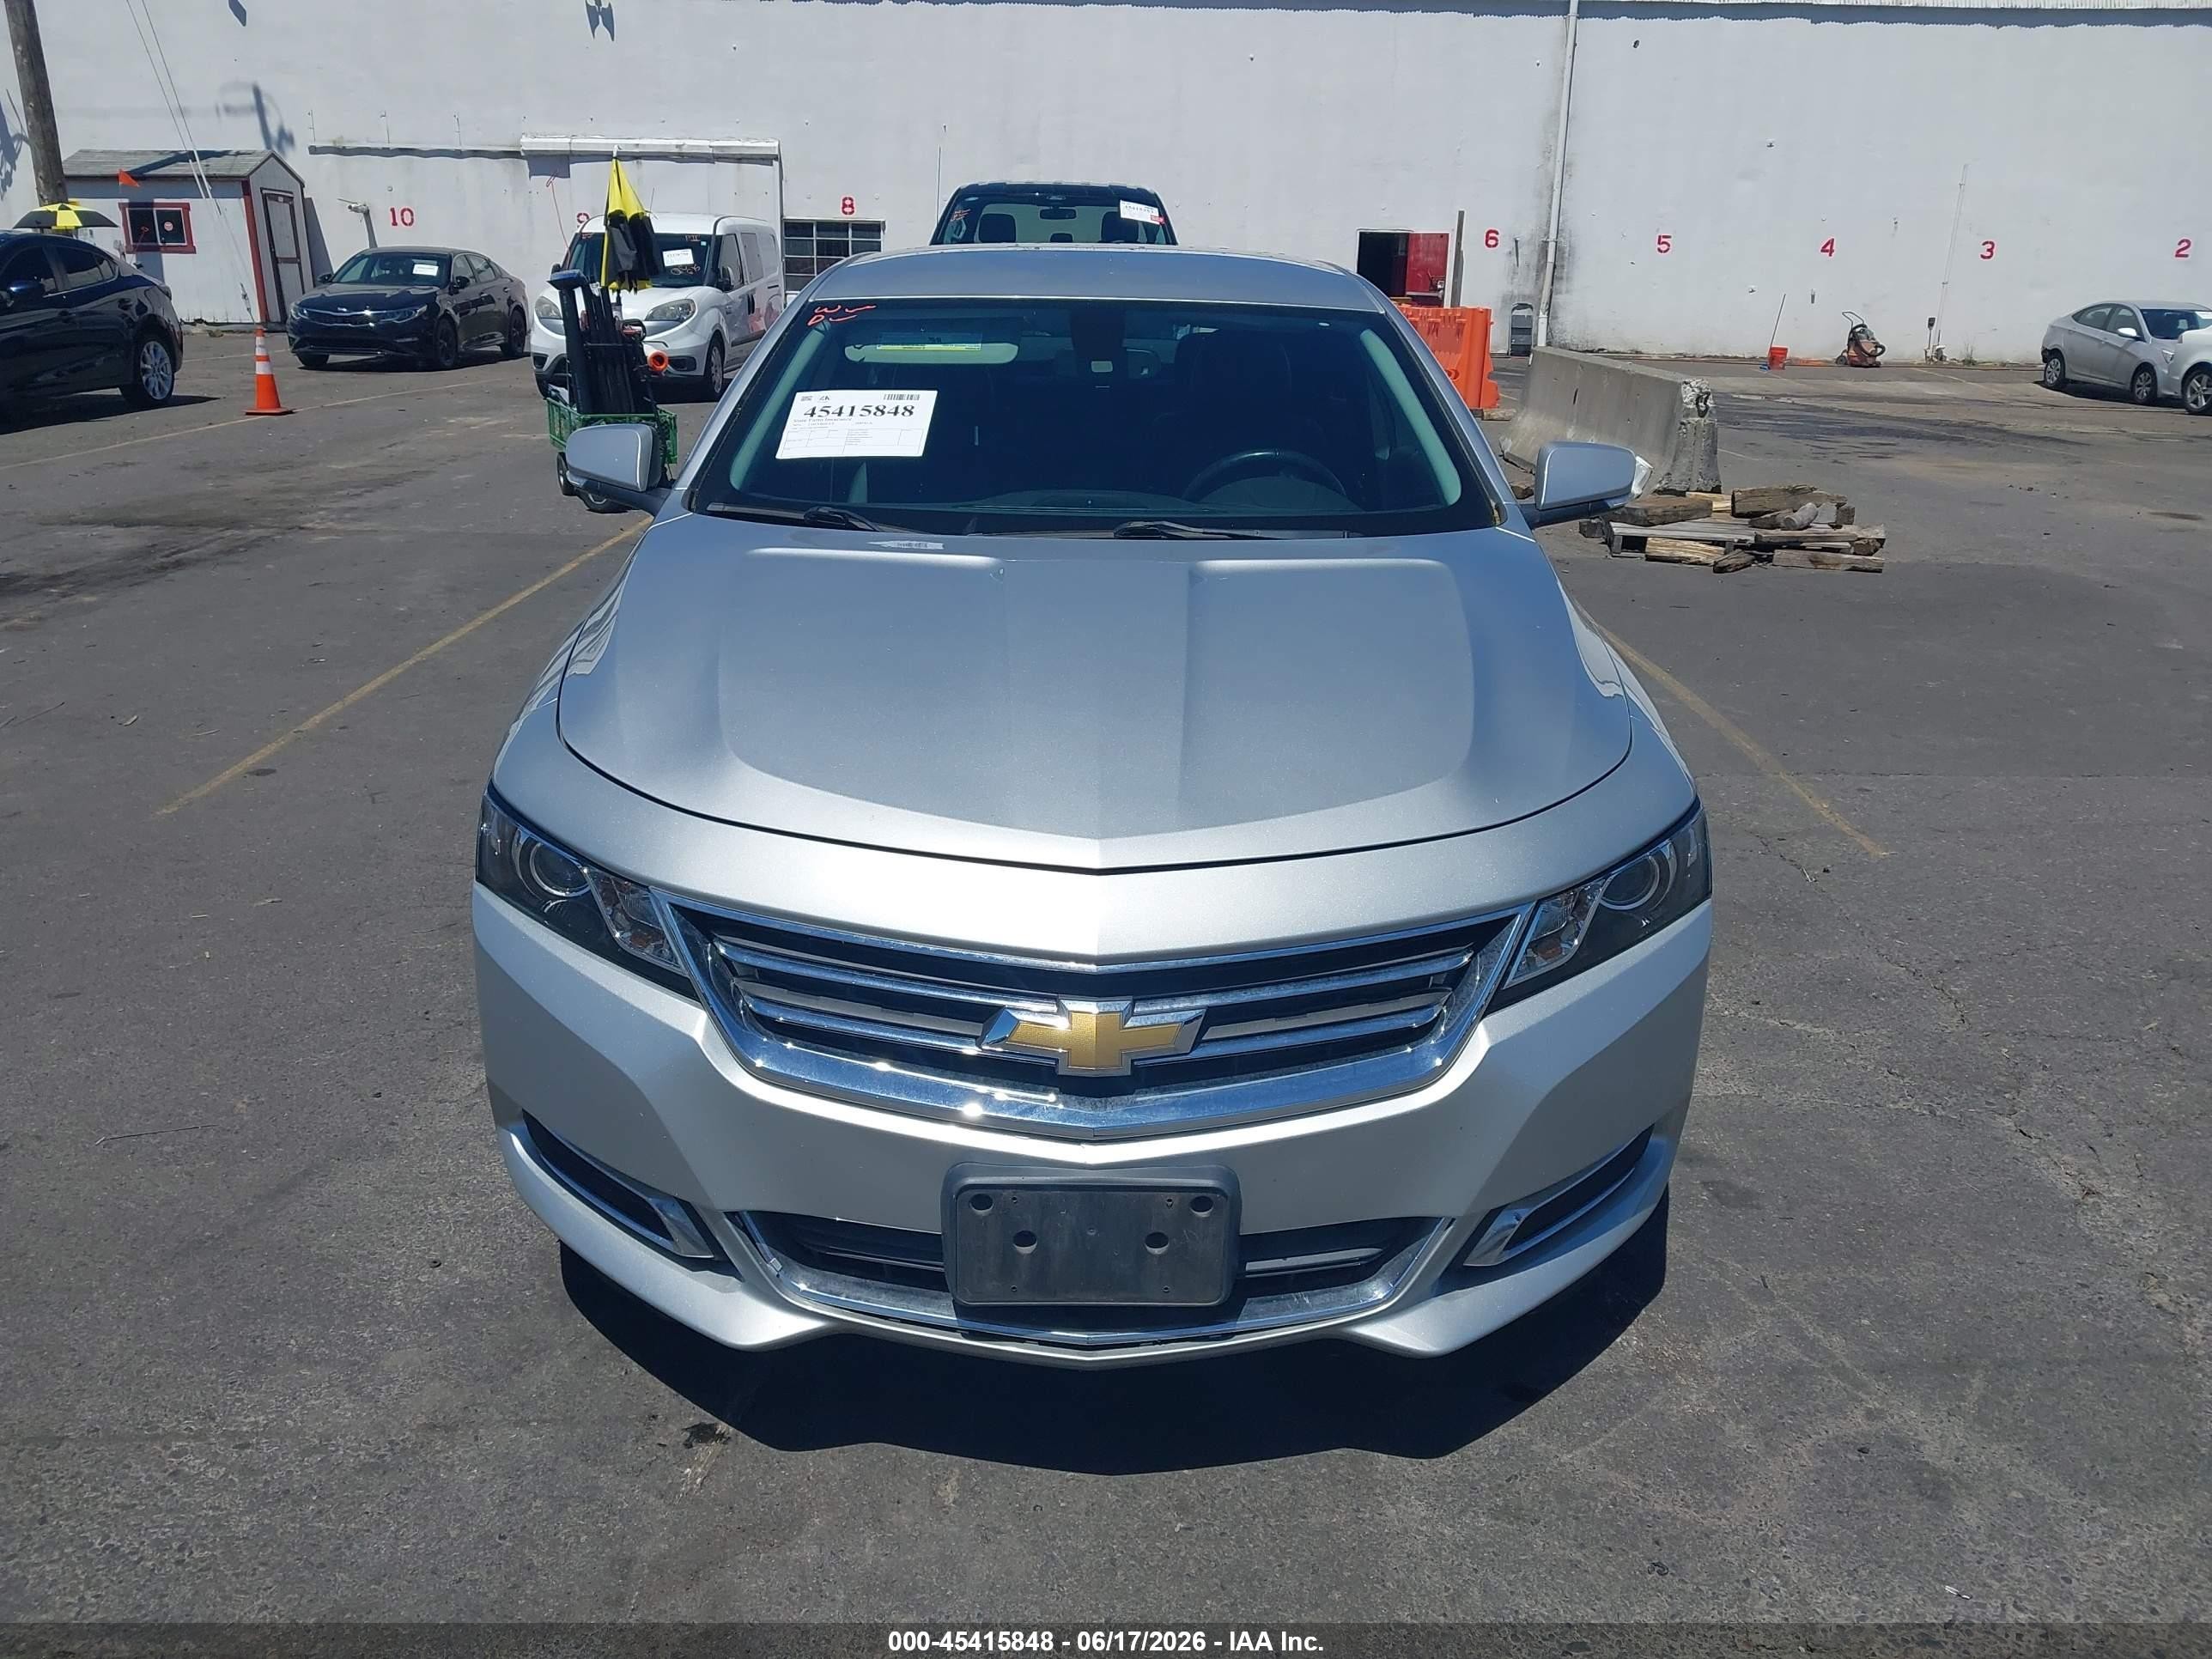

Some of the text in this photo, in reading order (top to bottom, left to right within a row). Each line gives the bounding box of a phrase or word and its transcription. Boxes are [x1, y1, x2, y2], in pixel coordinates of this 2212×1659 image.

[840, 196, 857, 216] 8
[390, 207, 415, 227] 10
[1483, 227, 1499, 249] 6
[1656, 234, 1673, 255] 5
[1819, 237, 1837, 258] 4
[2174, 238, 2192, 258] 2
[1980, 240, 1997, 261] 3
[803, 404, 915, 418] 45415848
